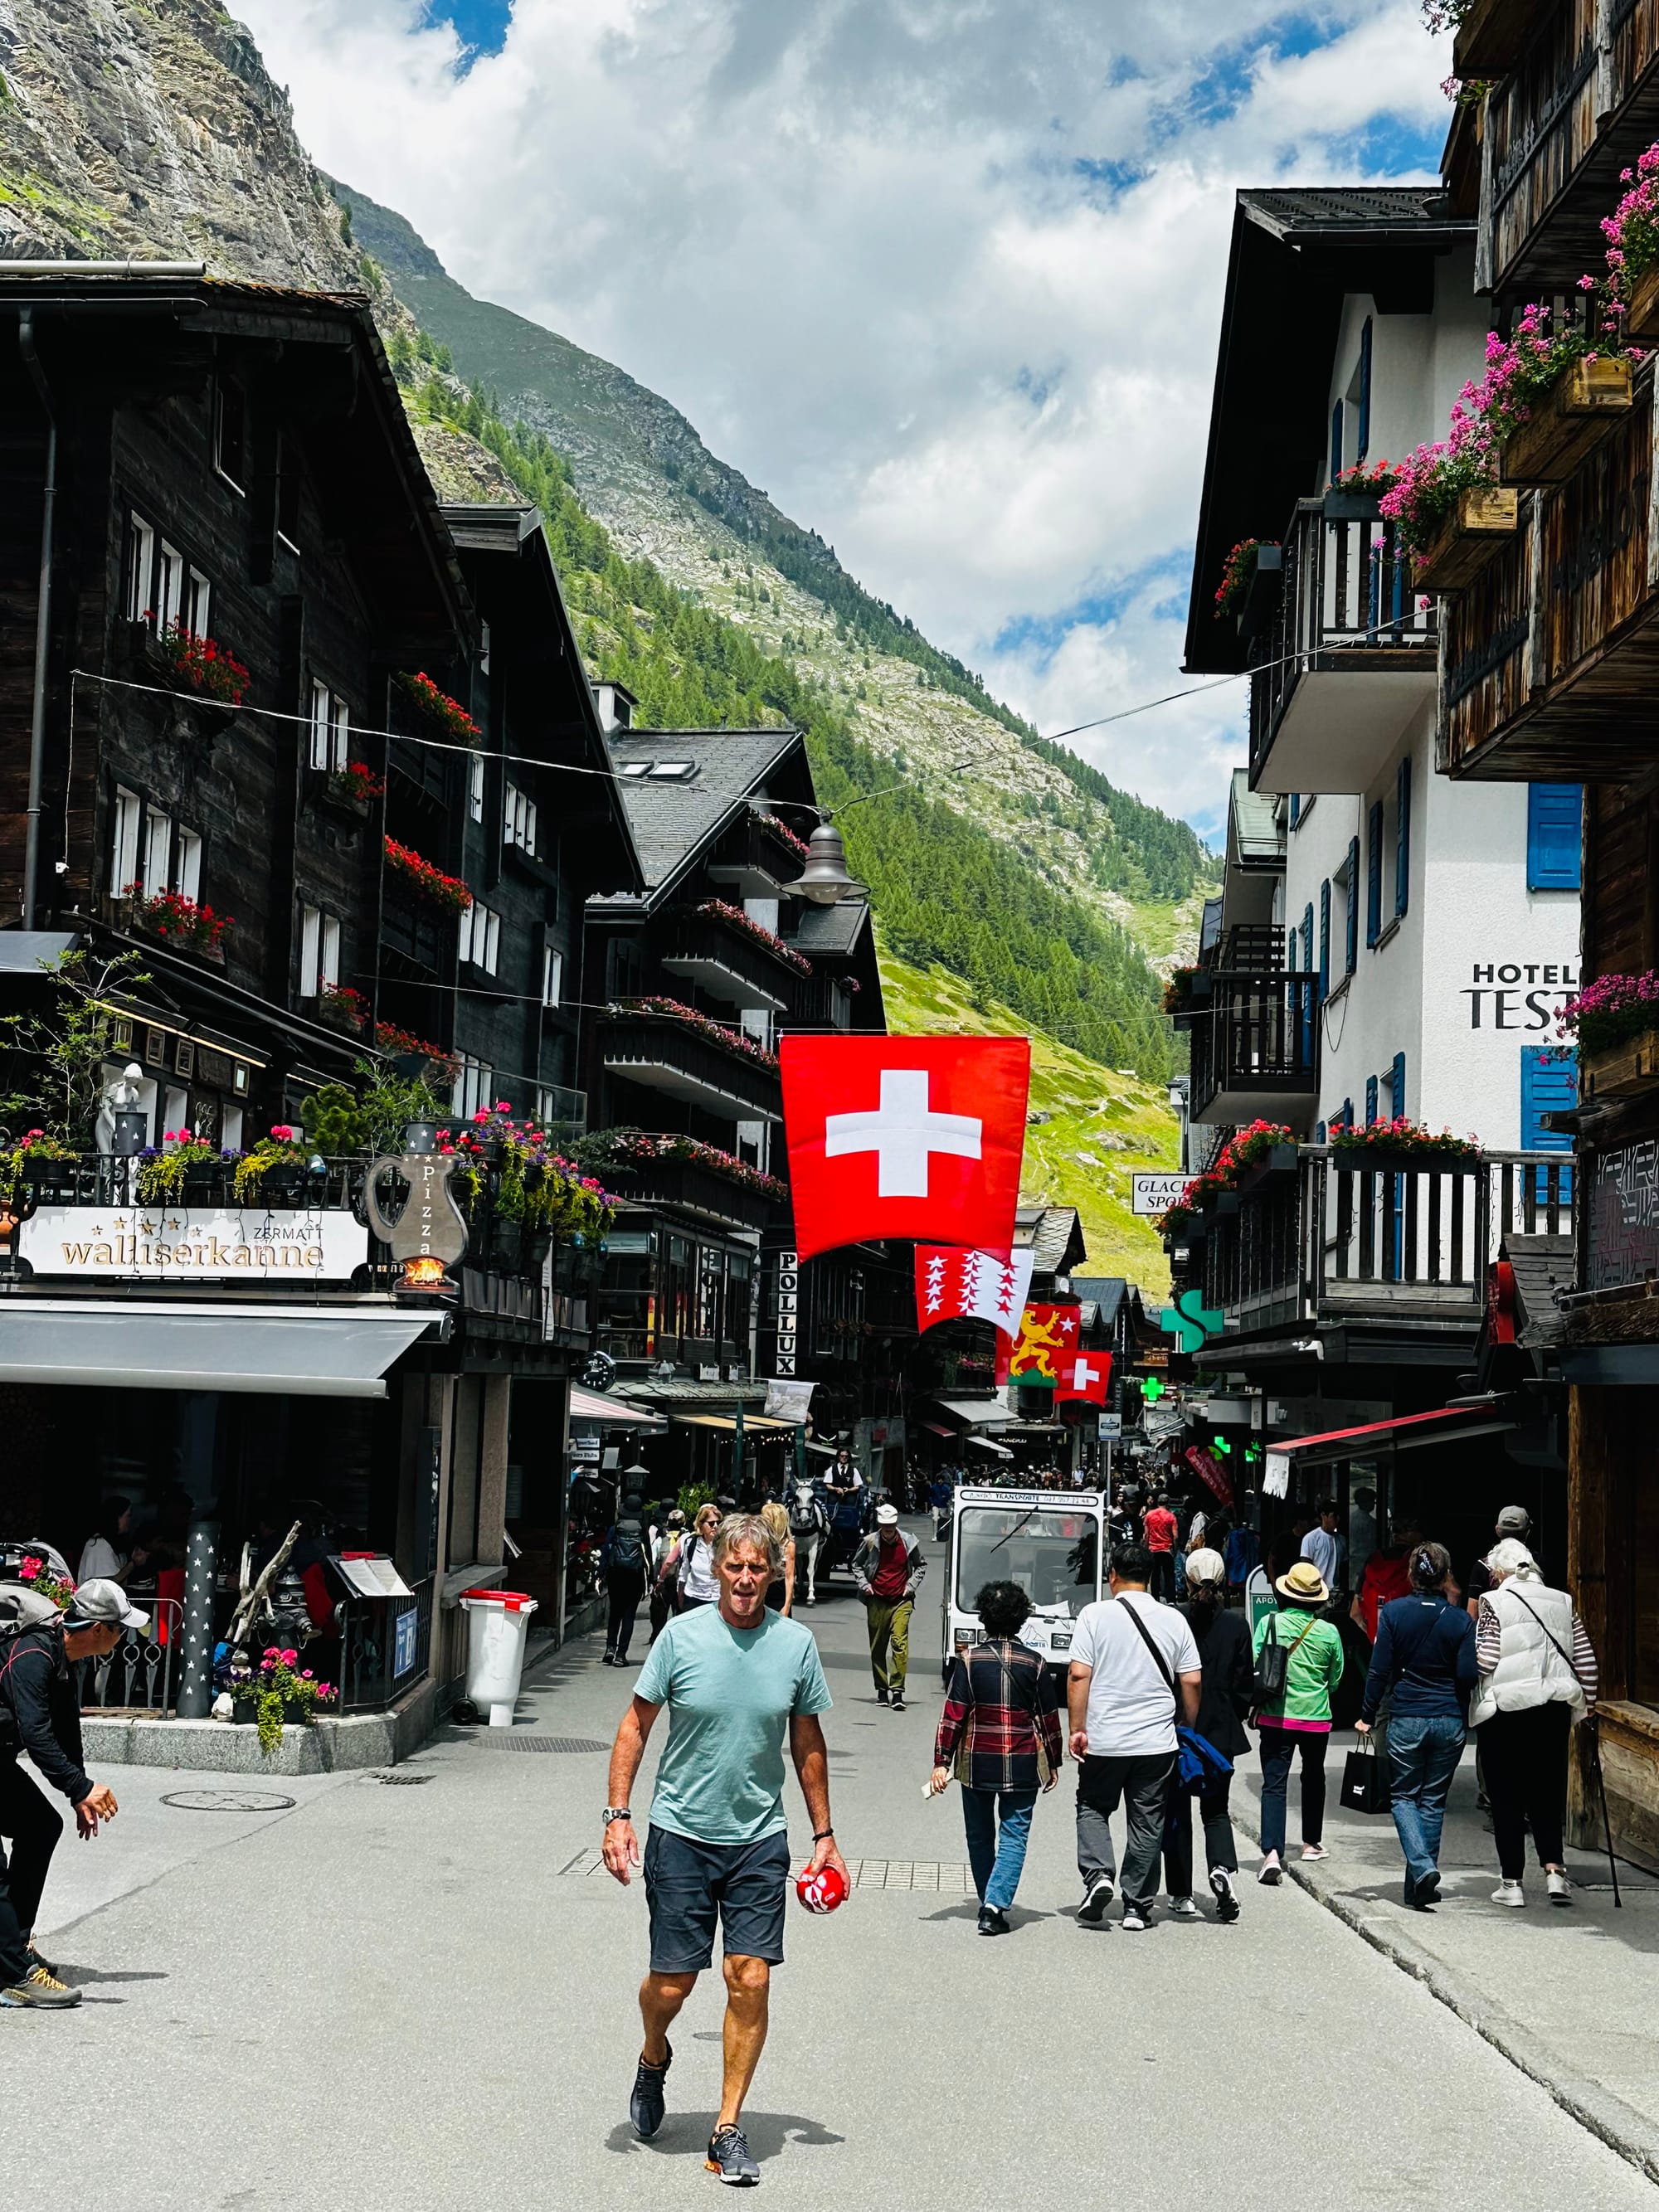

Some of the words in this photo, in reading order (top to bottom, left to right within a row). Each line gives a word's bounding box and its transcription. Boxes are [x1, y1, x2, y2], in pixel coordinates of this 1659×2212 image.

[1473, 964, 1578, 984] HOTEL
[1137, 1180, 1191, 1193] GLACI
[420, 1165, 435, 1255] Pizza
[253, 1227, 323, 1240] ZERMATT
[61, 1235, 324, 1269] walliserkanne
[777, 1253, 797, 1373] POLLUX
[1255, 1597, 1275, 1605] APO
